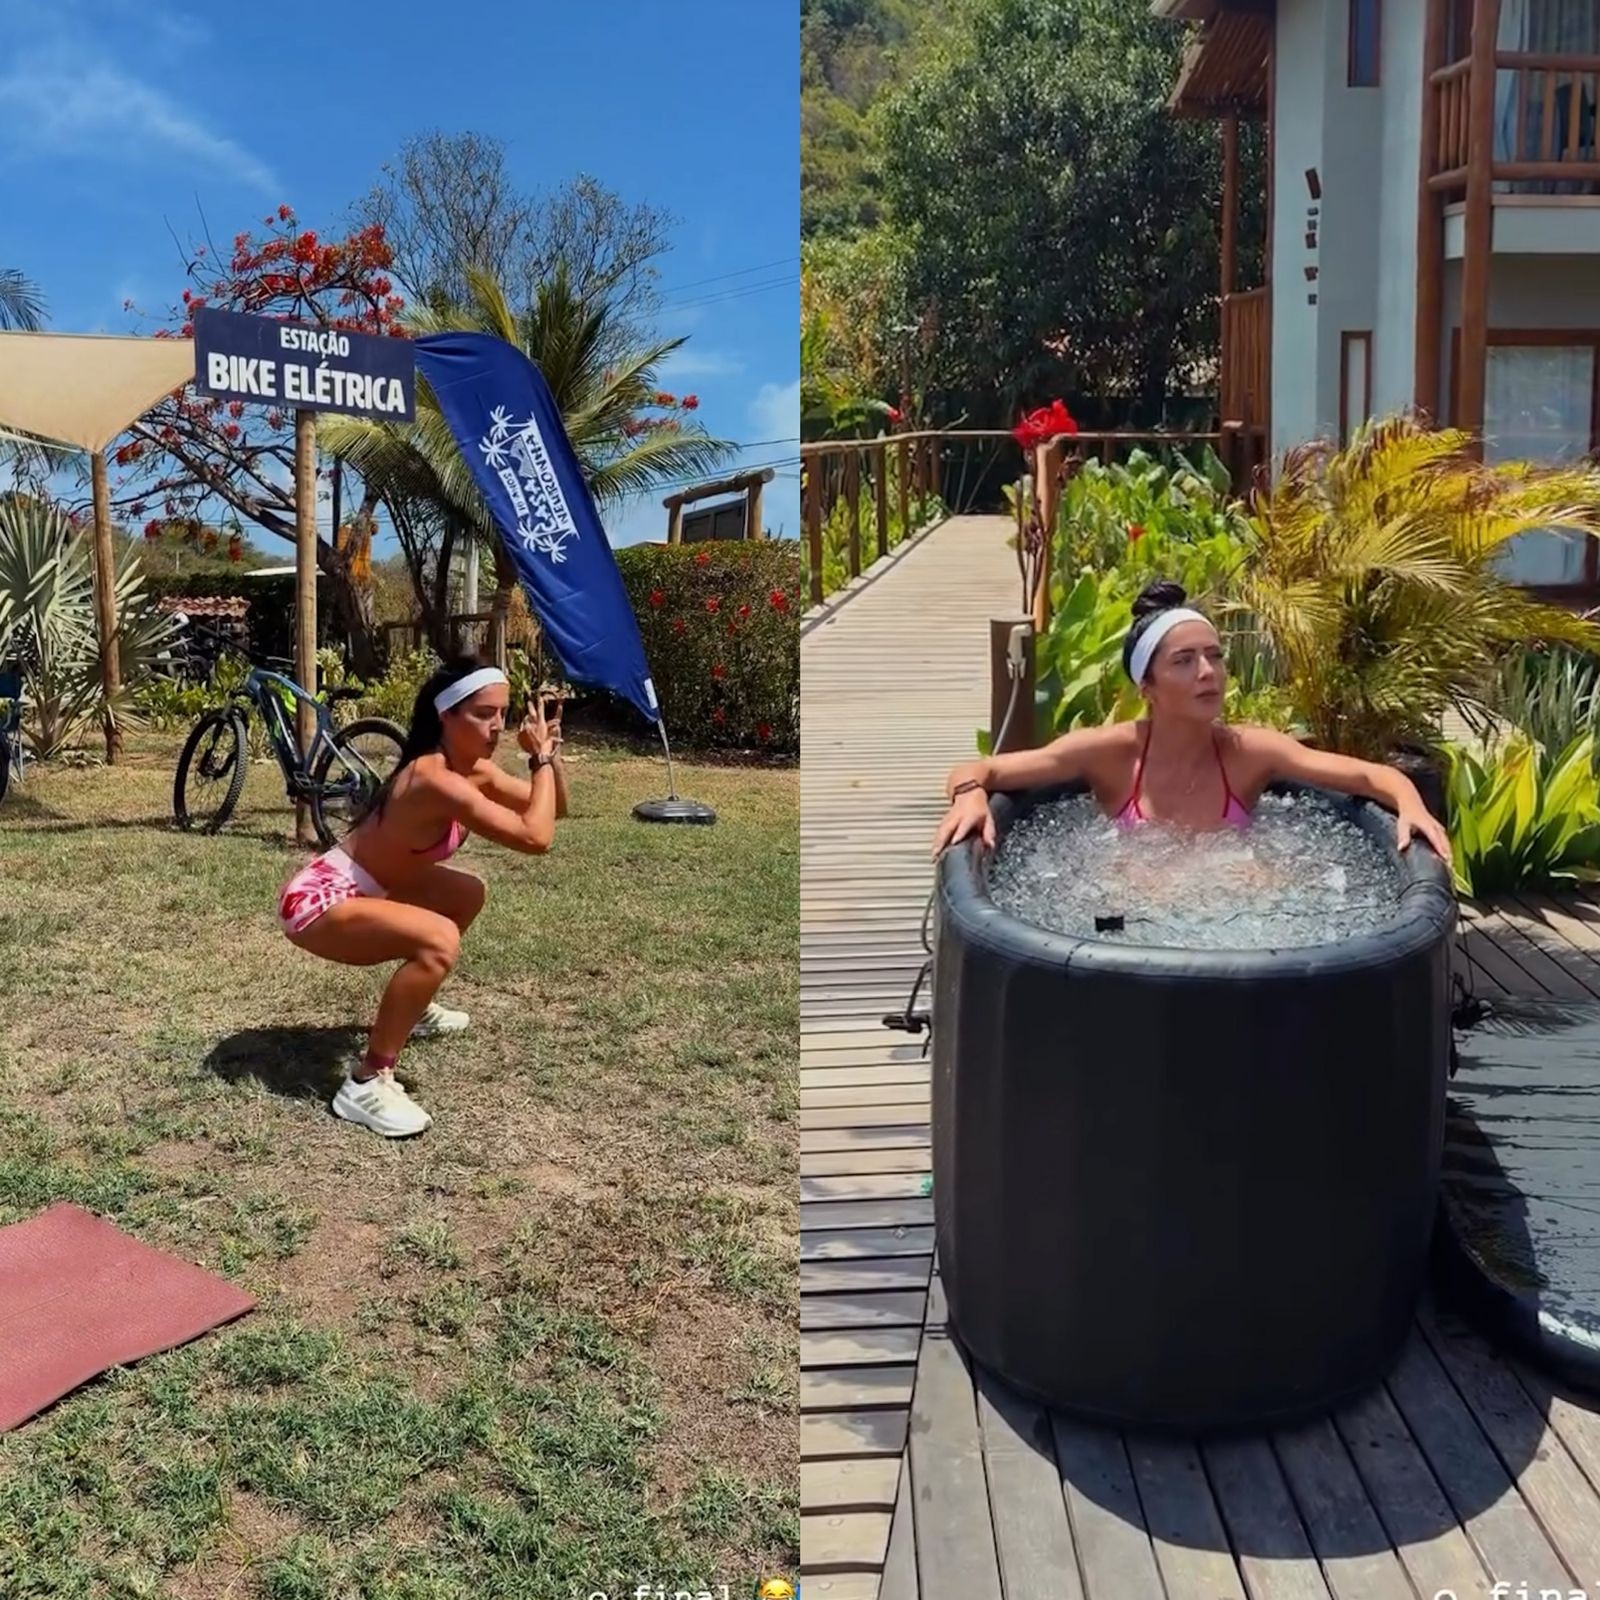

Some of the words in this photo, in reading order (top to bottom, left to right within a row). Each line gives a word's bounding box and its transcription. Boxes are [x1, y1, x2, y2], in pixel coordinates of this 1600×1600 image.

[280, 326, 350, 360] ESTAÇÃO
[207, 351, 277, 398] BIKE
[283, 361, 406, 414] ELÉTRICA
[502, 472, 518, 500] ANOS
[524, 478, 558, 532] CASA
[525, 434, 570, 526] NEURONHA
